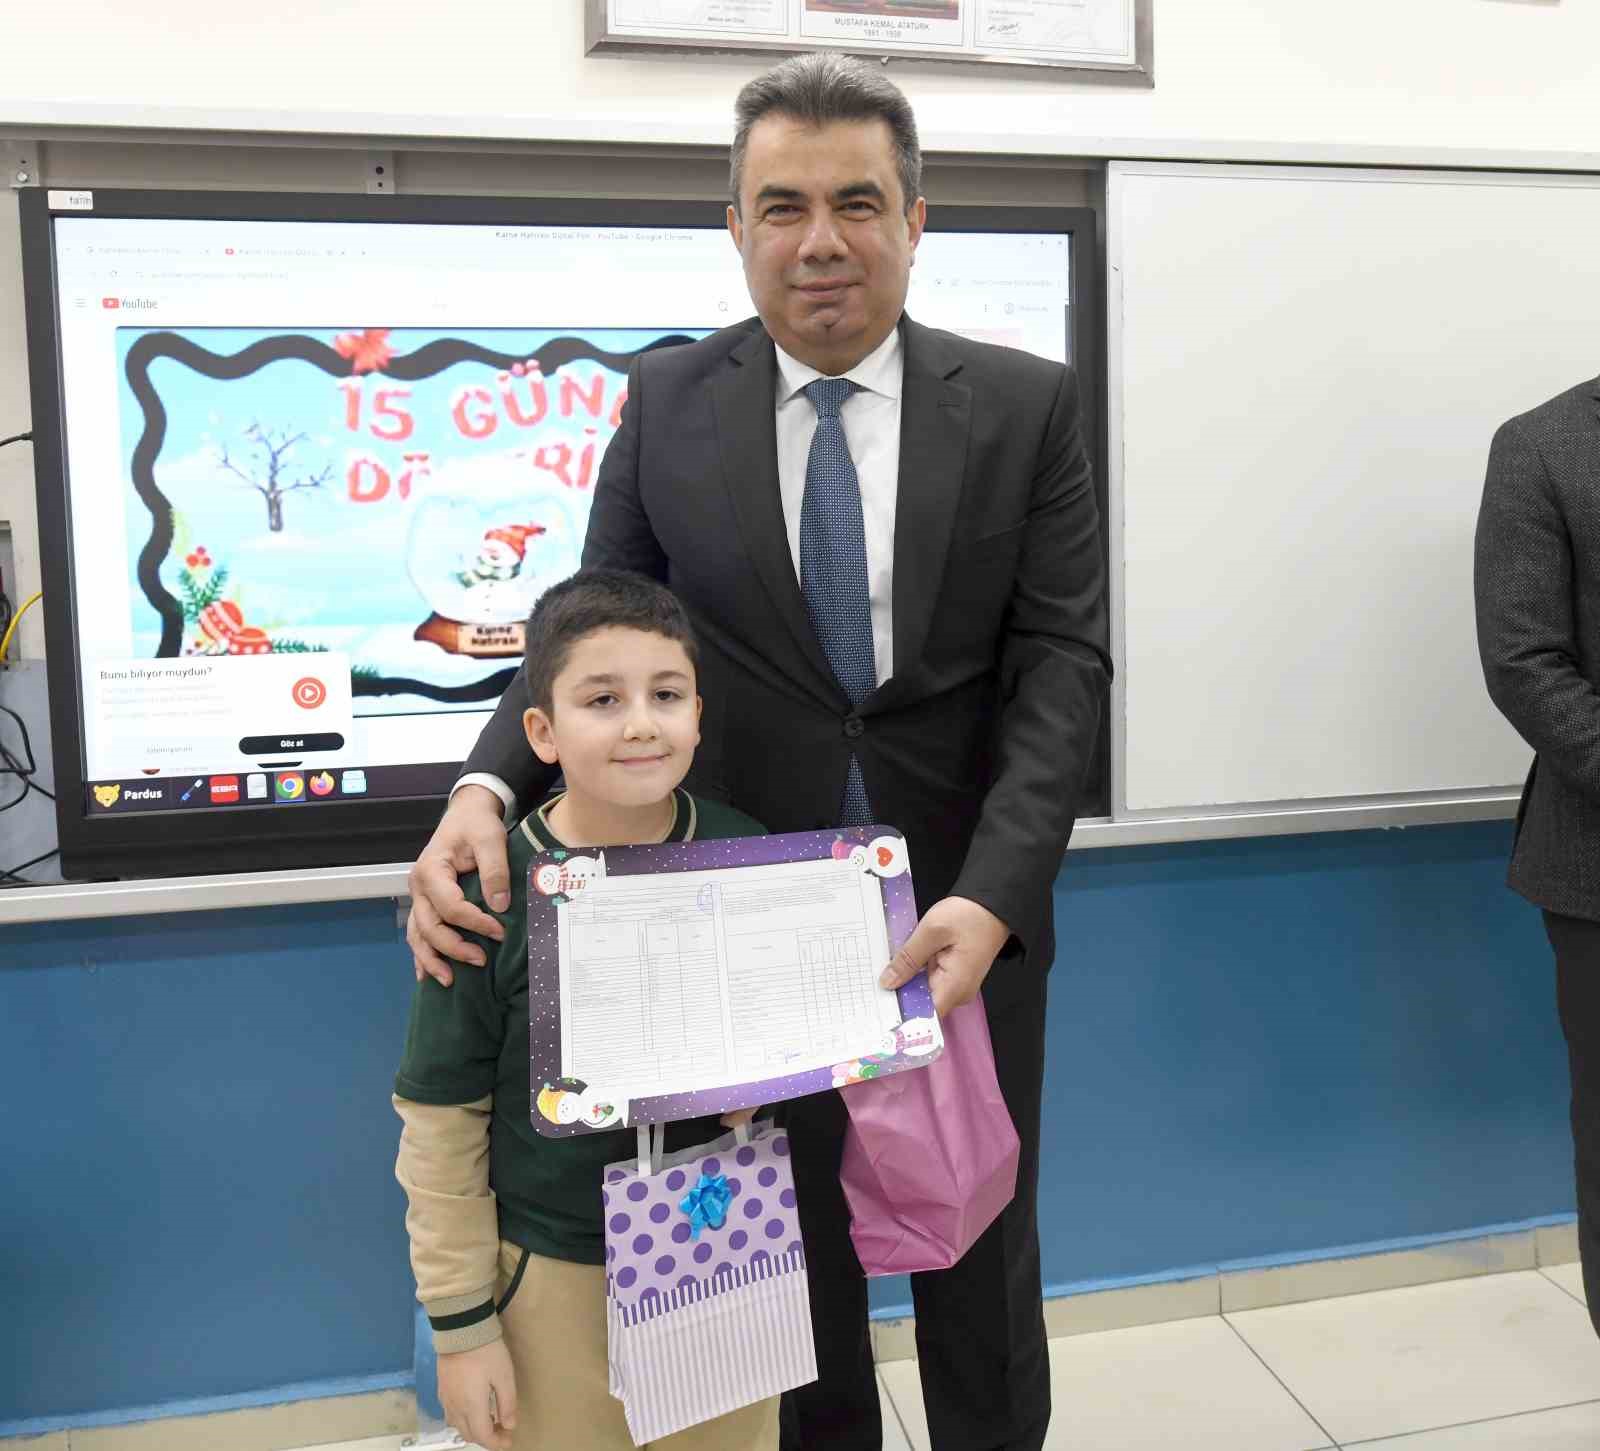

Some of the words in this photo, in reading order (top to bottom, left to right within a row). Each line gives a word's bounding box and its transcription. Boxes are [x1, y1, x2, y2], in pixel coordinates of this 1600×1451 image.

[121, 298, 158, 309] YouTube
[340, 383, 414, 441] 15
[100, 671, 127, 680] Bunu
[124, 788, 163, 800] Pardus
